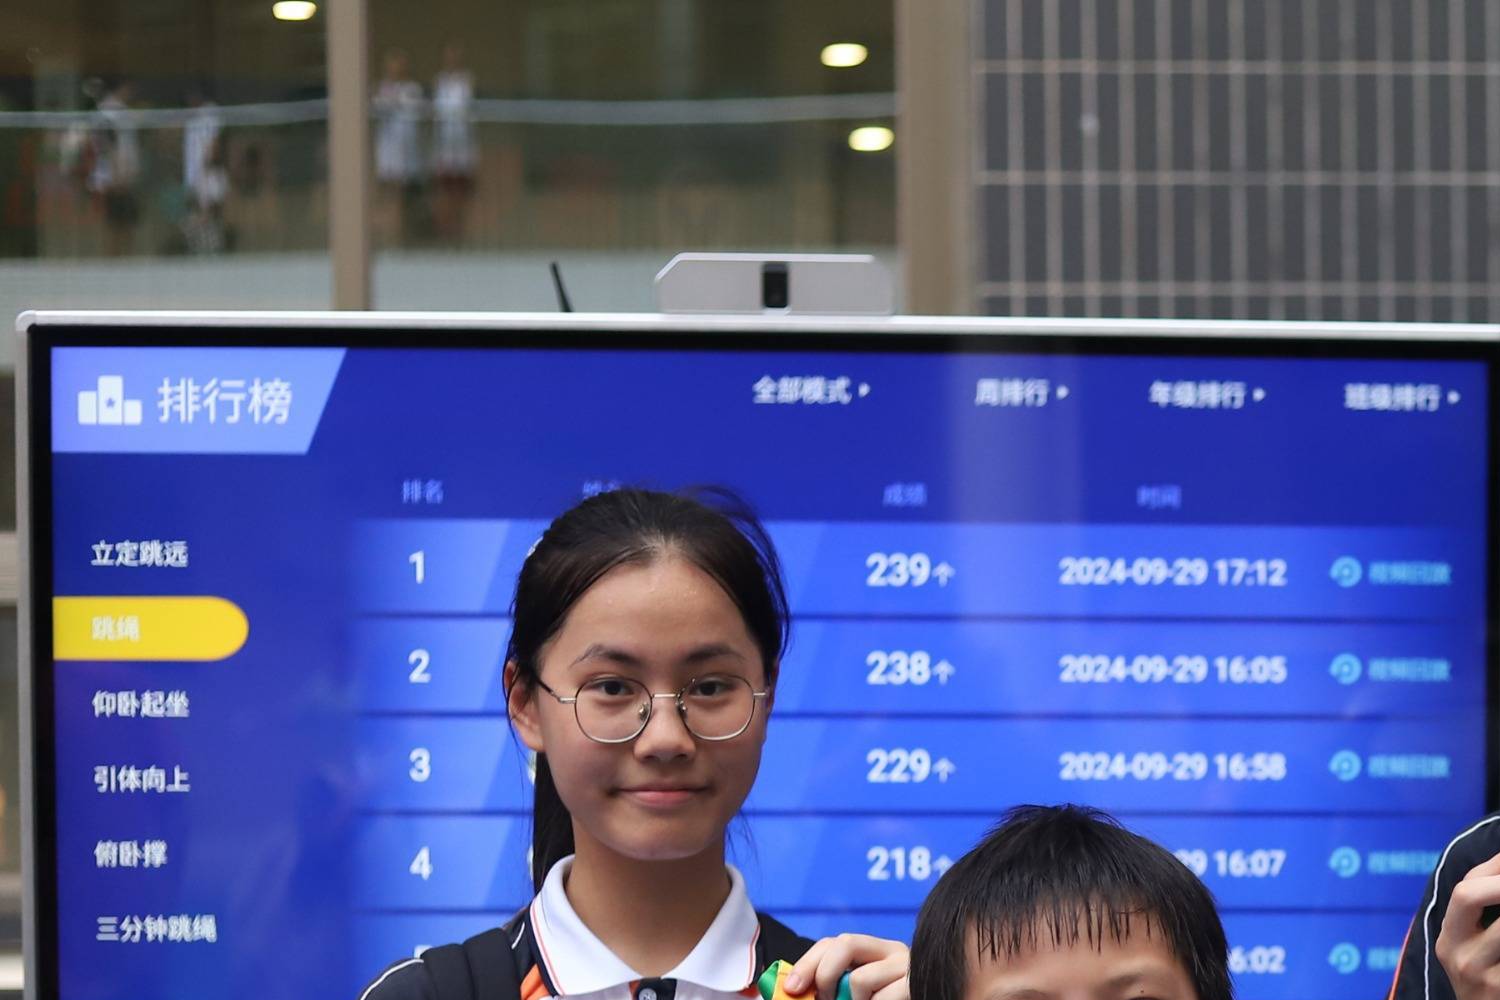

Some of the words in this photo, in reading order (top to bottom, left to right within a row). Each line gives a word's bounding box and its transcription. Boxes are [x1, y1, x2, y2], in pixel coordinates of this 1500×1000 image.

[157, 377, 292, 424] 排行榜
[753, 376, 852, 404] 全部模式
[975, 378, 1050, 406] 周排行
[1149, 381, 1247, 409] 年级排行
[91, 540, 189, 567] 立定跳远
[409, 550, 426, 584] 1
[1058, 557, 1208, 586] 2024-09-29
[1214, 558, 1288, 588] 17:12
[92, 615, 140, 640] 跳绳
[408, 649, 431, 683] 2
[1058, 654, 1208, 684] 2024-09-29
[1214, 655, 1288, 684] 16:05
[92, 690, 190, 718] 仰卧起坐
[94, 764, 191, 793] 引体向上
[408, 747, 431, 783] 3
[1058, 752, 1208, 781] 2024-09-29
[1214, 752, 1288, 782] 16:58
[94, 840, 168, 868] 俯卧撑
[409, 846, 433, 881] 4
[1214, 849, 1287, 877] 16:07
[96, 914, 217, 943] 三分钟跳绳
[1228, 946, 1287, 974] 6:02
